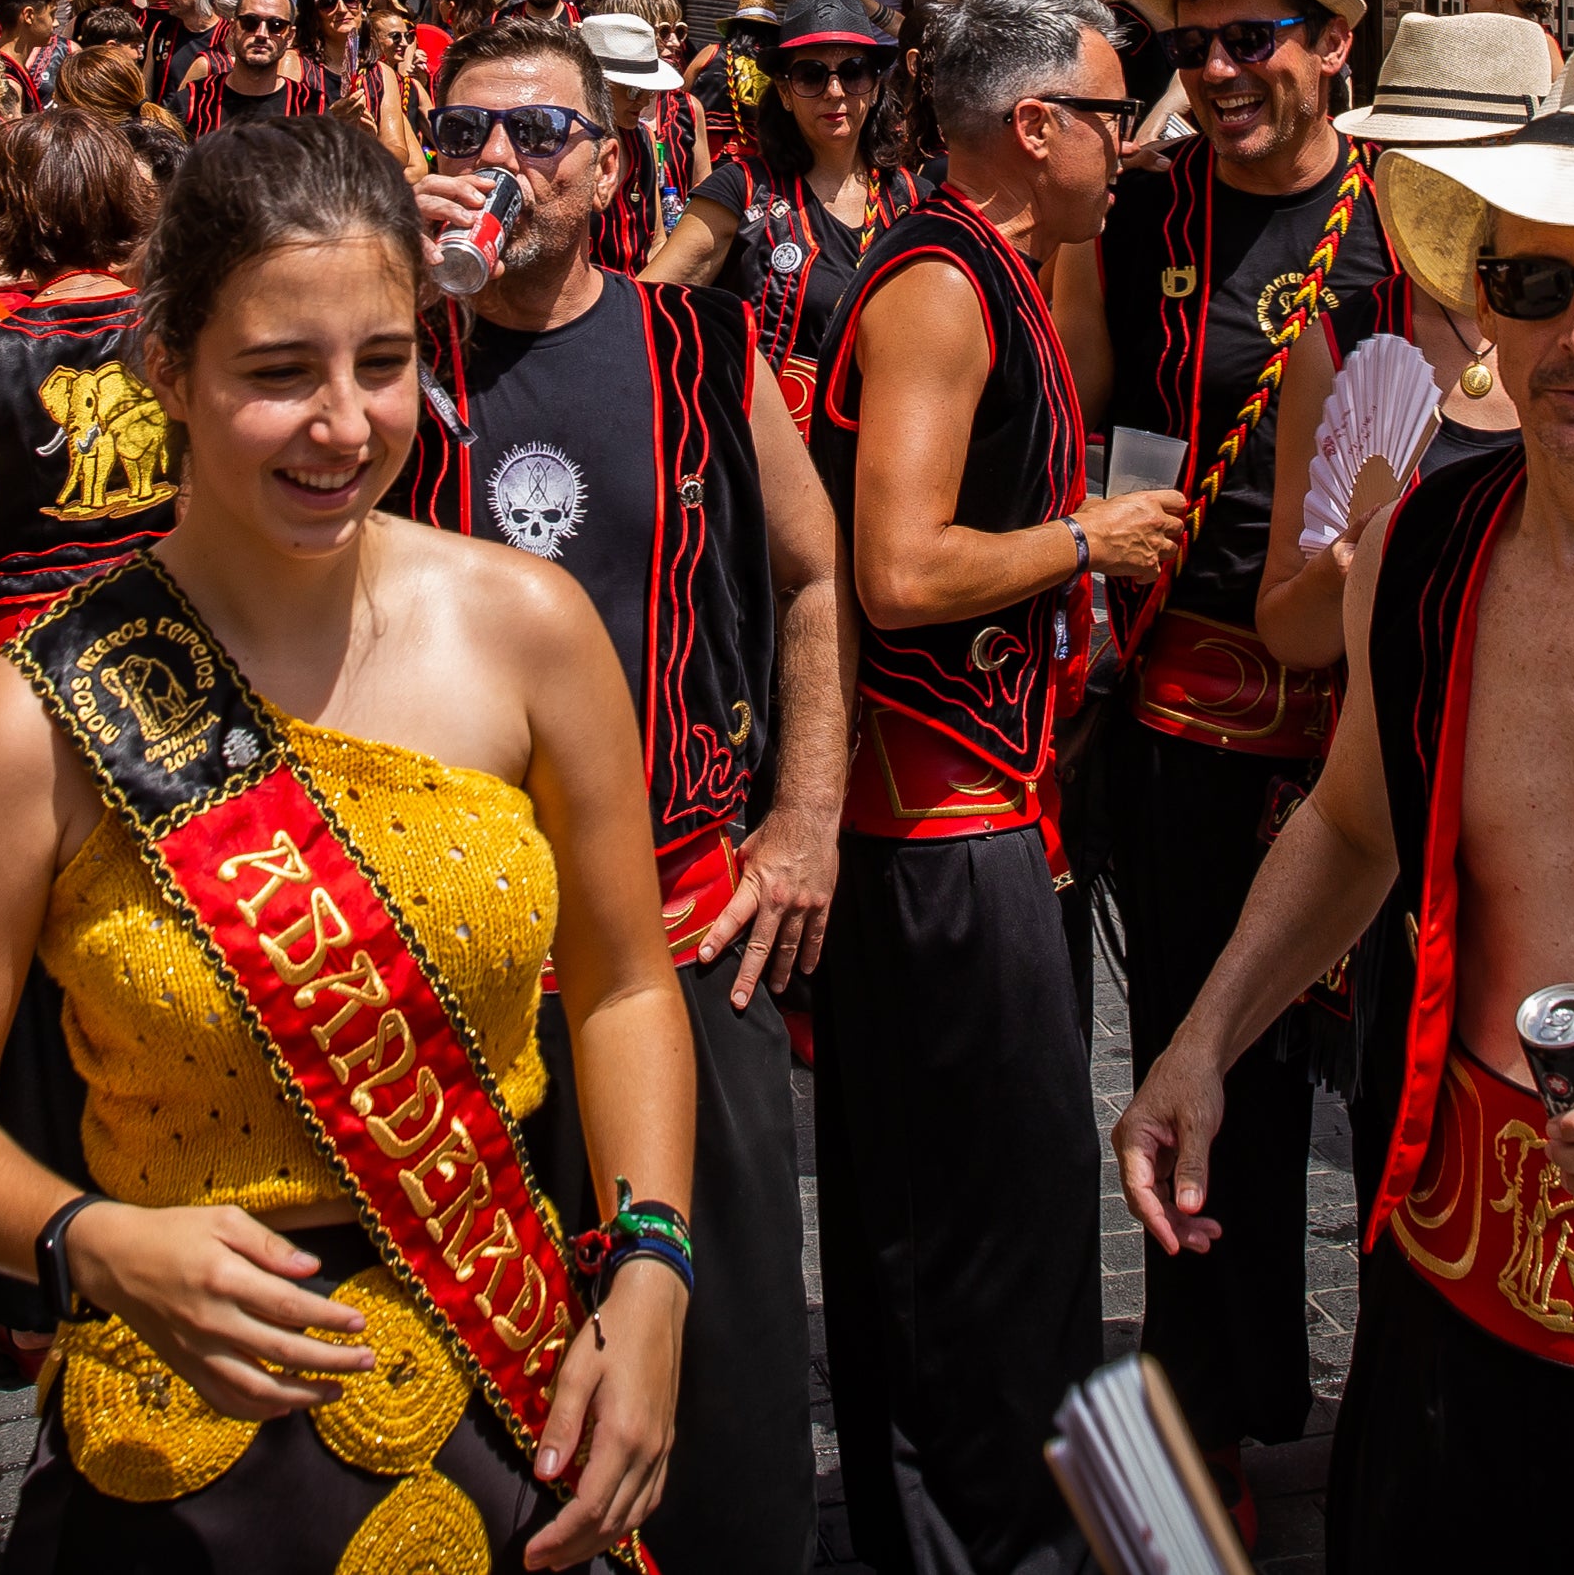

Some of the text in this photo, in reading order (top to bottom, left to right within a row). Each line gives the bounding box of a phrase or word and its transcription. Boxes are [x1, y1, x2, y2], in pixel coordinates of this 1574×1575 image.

[70, 616, 216, 746] MOROS NEGROS EGIPCIOS
[163, 739, 208, 775] 2024
